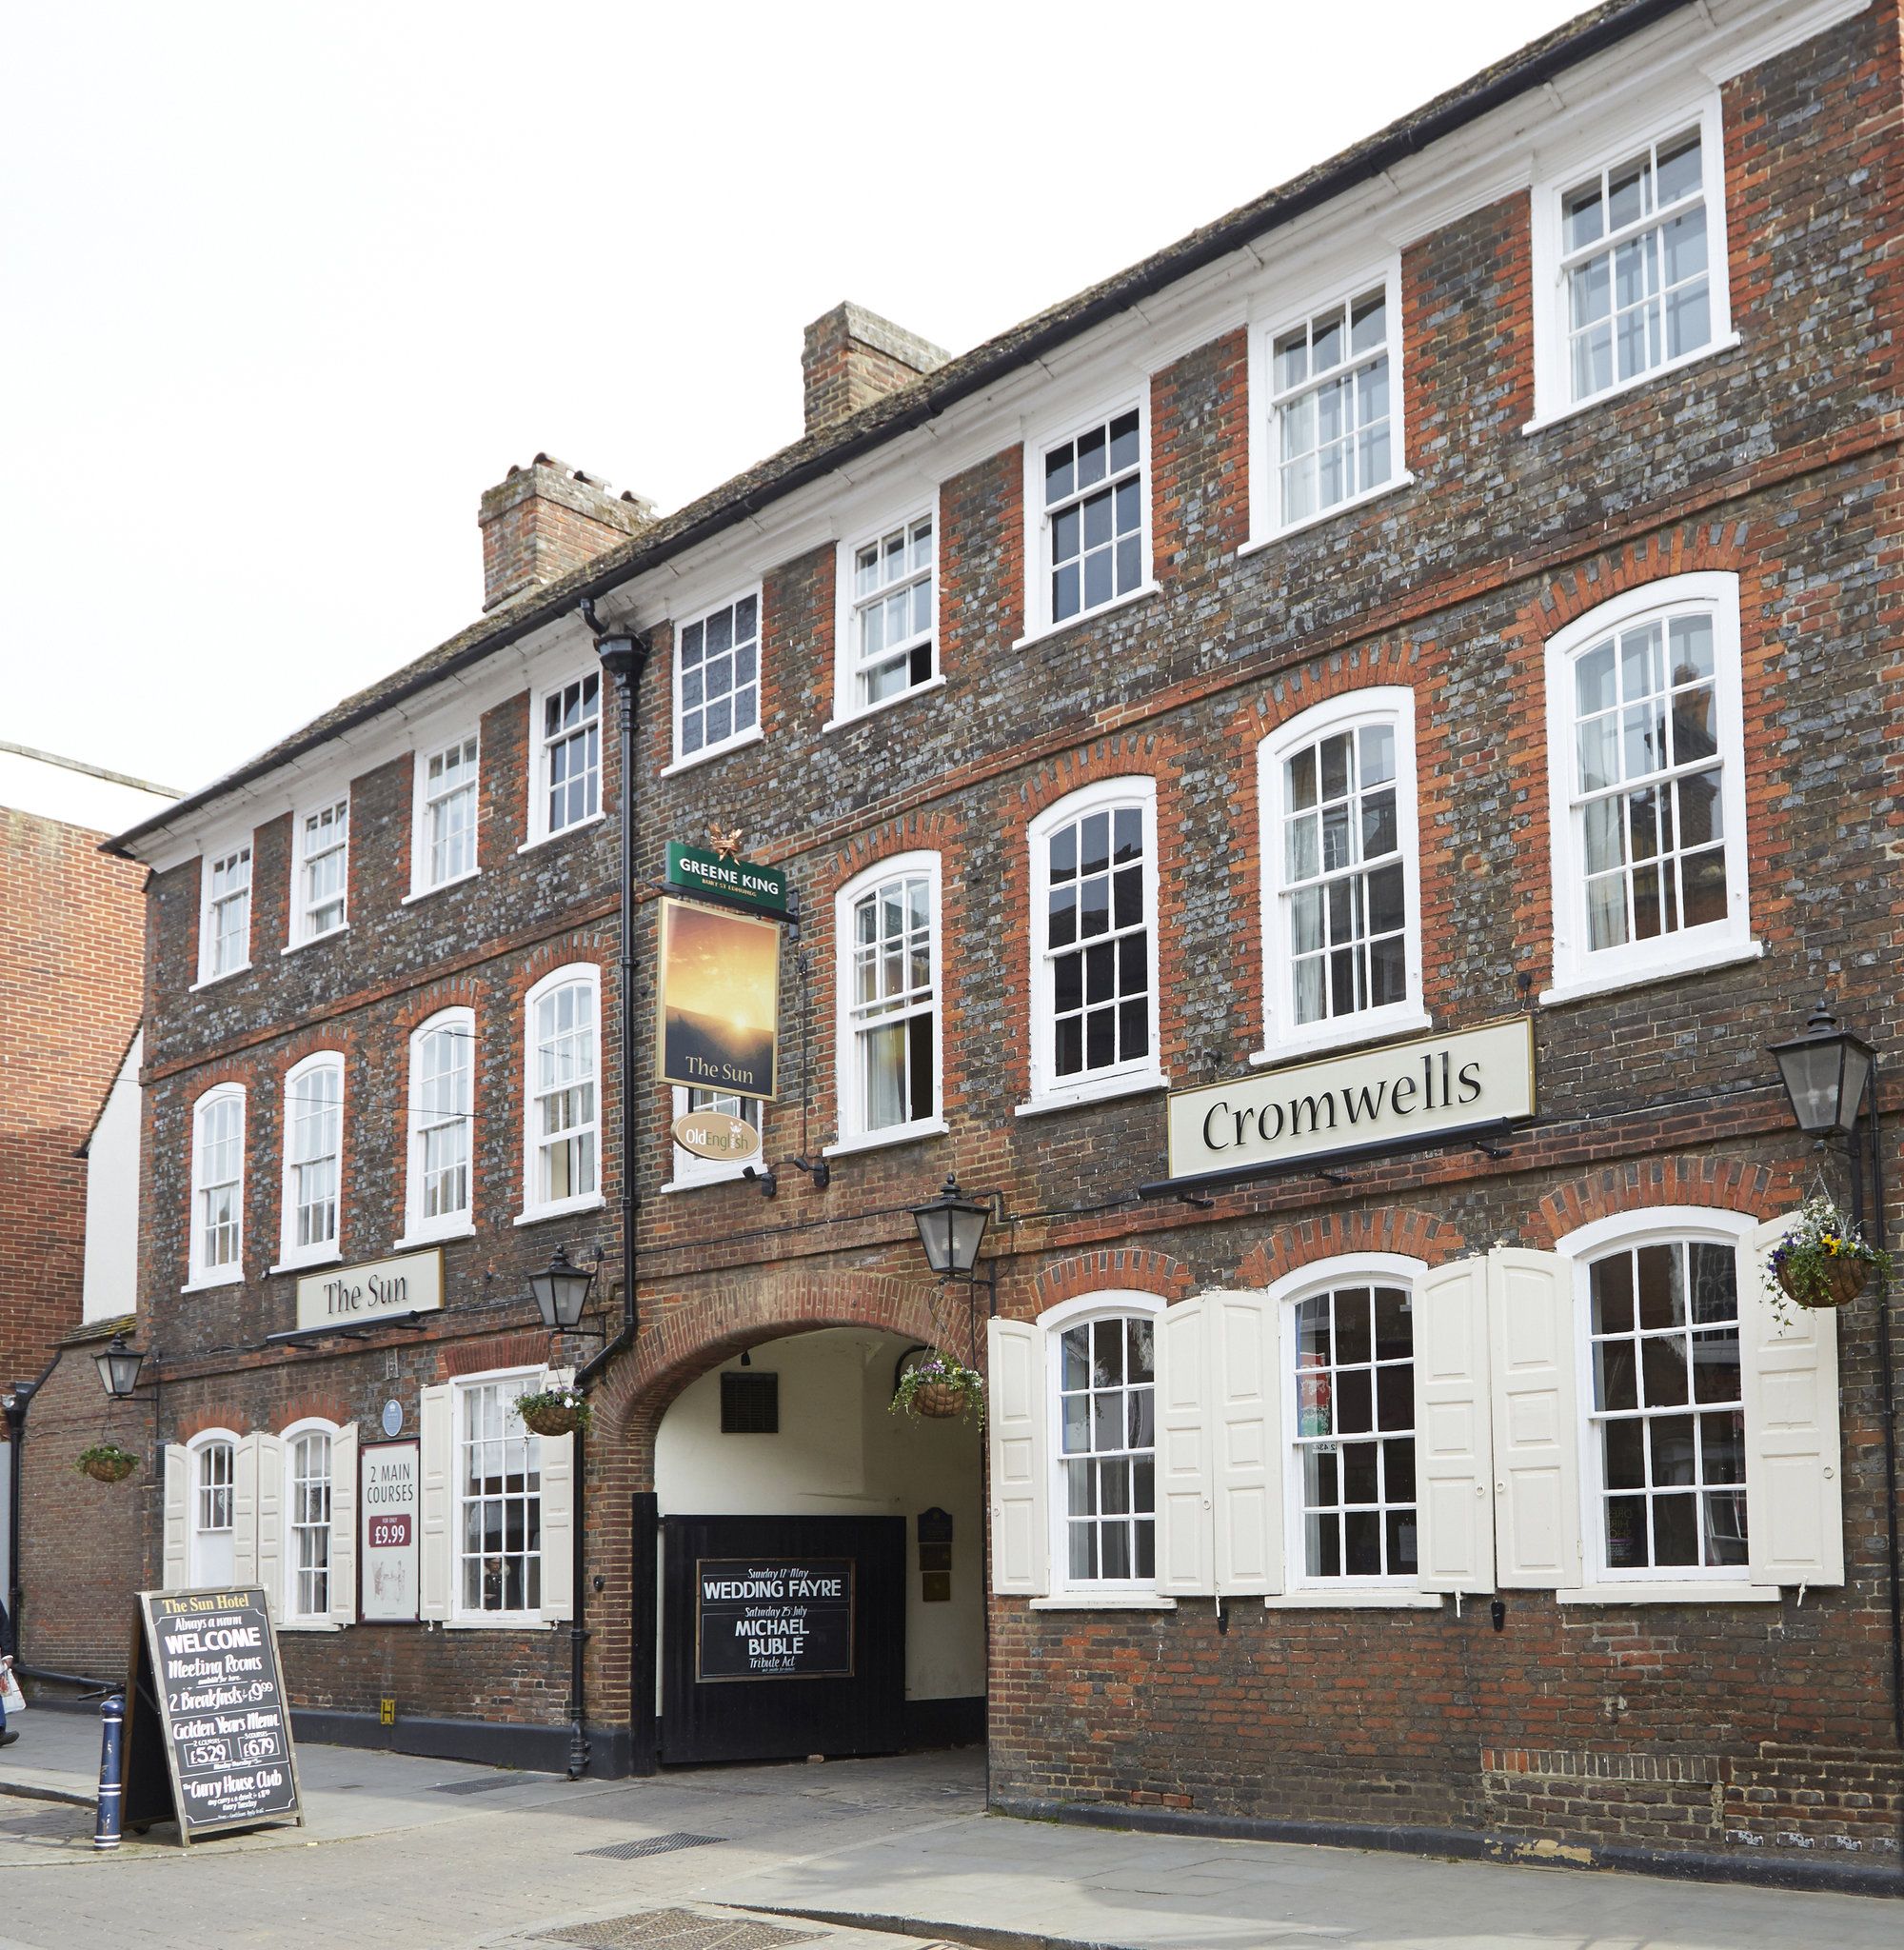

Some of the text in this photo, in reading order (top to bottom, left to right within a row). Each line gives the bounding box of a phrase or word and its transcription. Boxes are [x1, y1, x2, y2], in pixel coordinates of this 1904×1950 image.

[679, 858, 779, 895] GREENE KING
[685, 1056, 753, 1084] The Sun
[1202, 1050, 1481, 1151] Cromwells
[324, 1274, 407, 1314] The Sun
[370, 1463, 410, 1482] 2 MAIN
[367, 1484, 413, 1503] COURSES
[375, 1524, 405, 1544] £9.99
[747, 1568, 779, 1581] Sunday
[790, 1568, 809, 1581] May
[704, 1580, 842, 1600] WEDDING FAYRE
[163, 1593, 249, 1614] The Sun Hotel
[744, 1605, 781, 1619] Saturday
[792, 1605, 807, 1618] July
[175, 1616, 242, 1632] Always a warm
[735, 1619, 810, 1637] MICHAEL
[164, 1627, 262, 1655] WELCOME
[168, 1654, 263, 1679] Meeting Rooms
[749, 1656, 796, 1669] Tribute Act
[169, 1694, 180, 1712] 2
[181, 1685, 244, 1710] Breakfasts
[173, 1720, 216, 1741] Golden
[247, 1712, 280, 1730] Menu
[190, 1781, 223, 1799] Curry
[223, 1775, 256, 1793] House
[256, 1769, 283, 1788] Club
